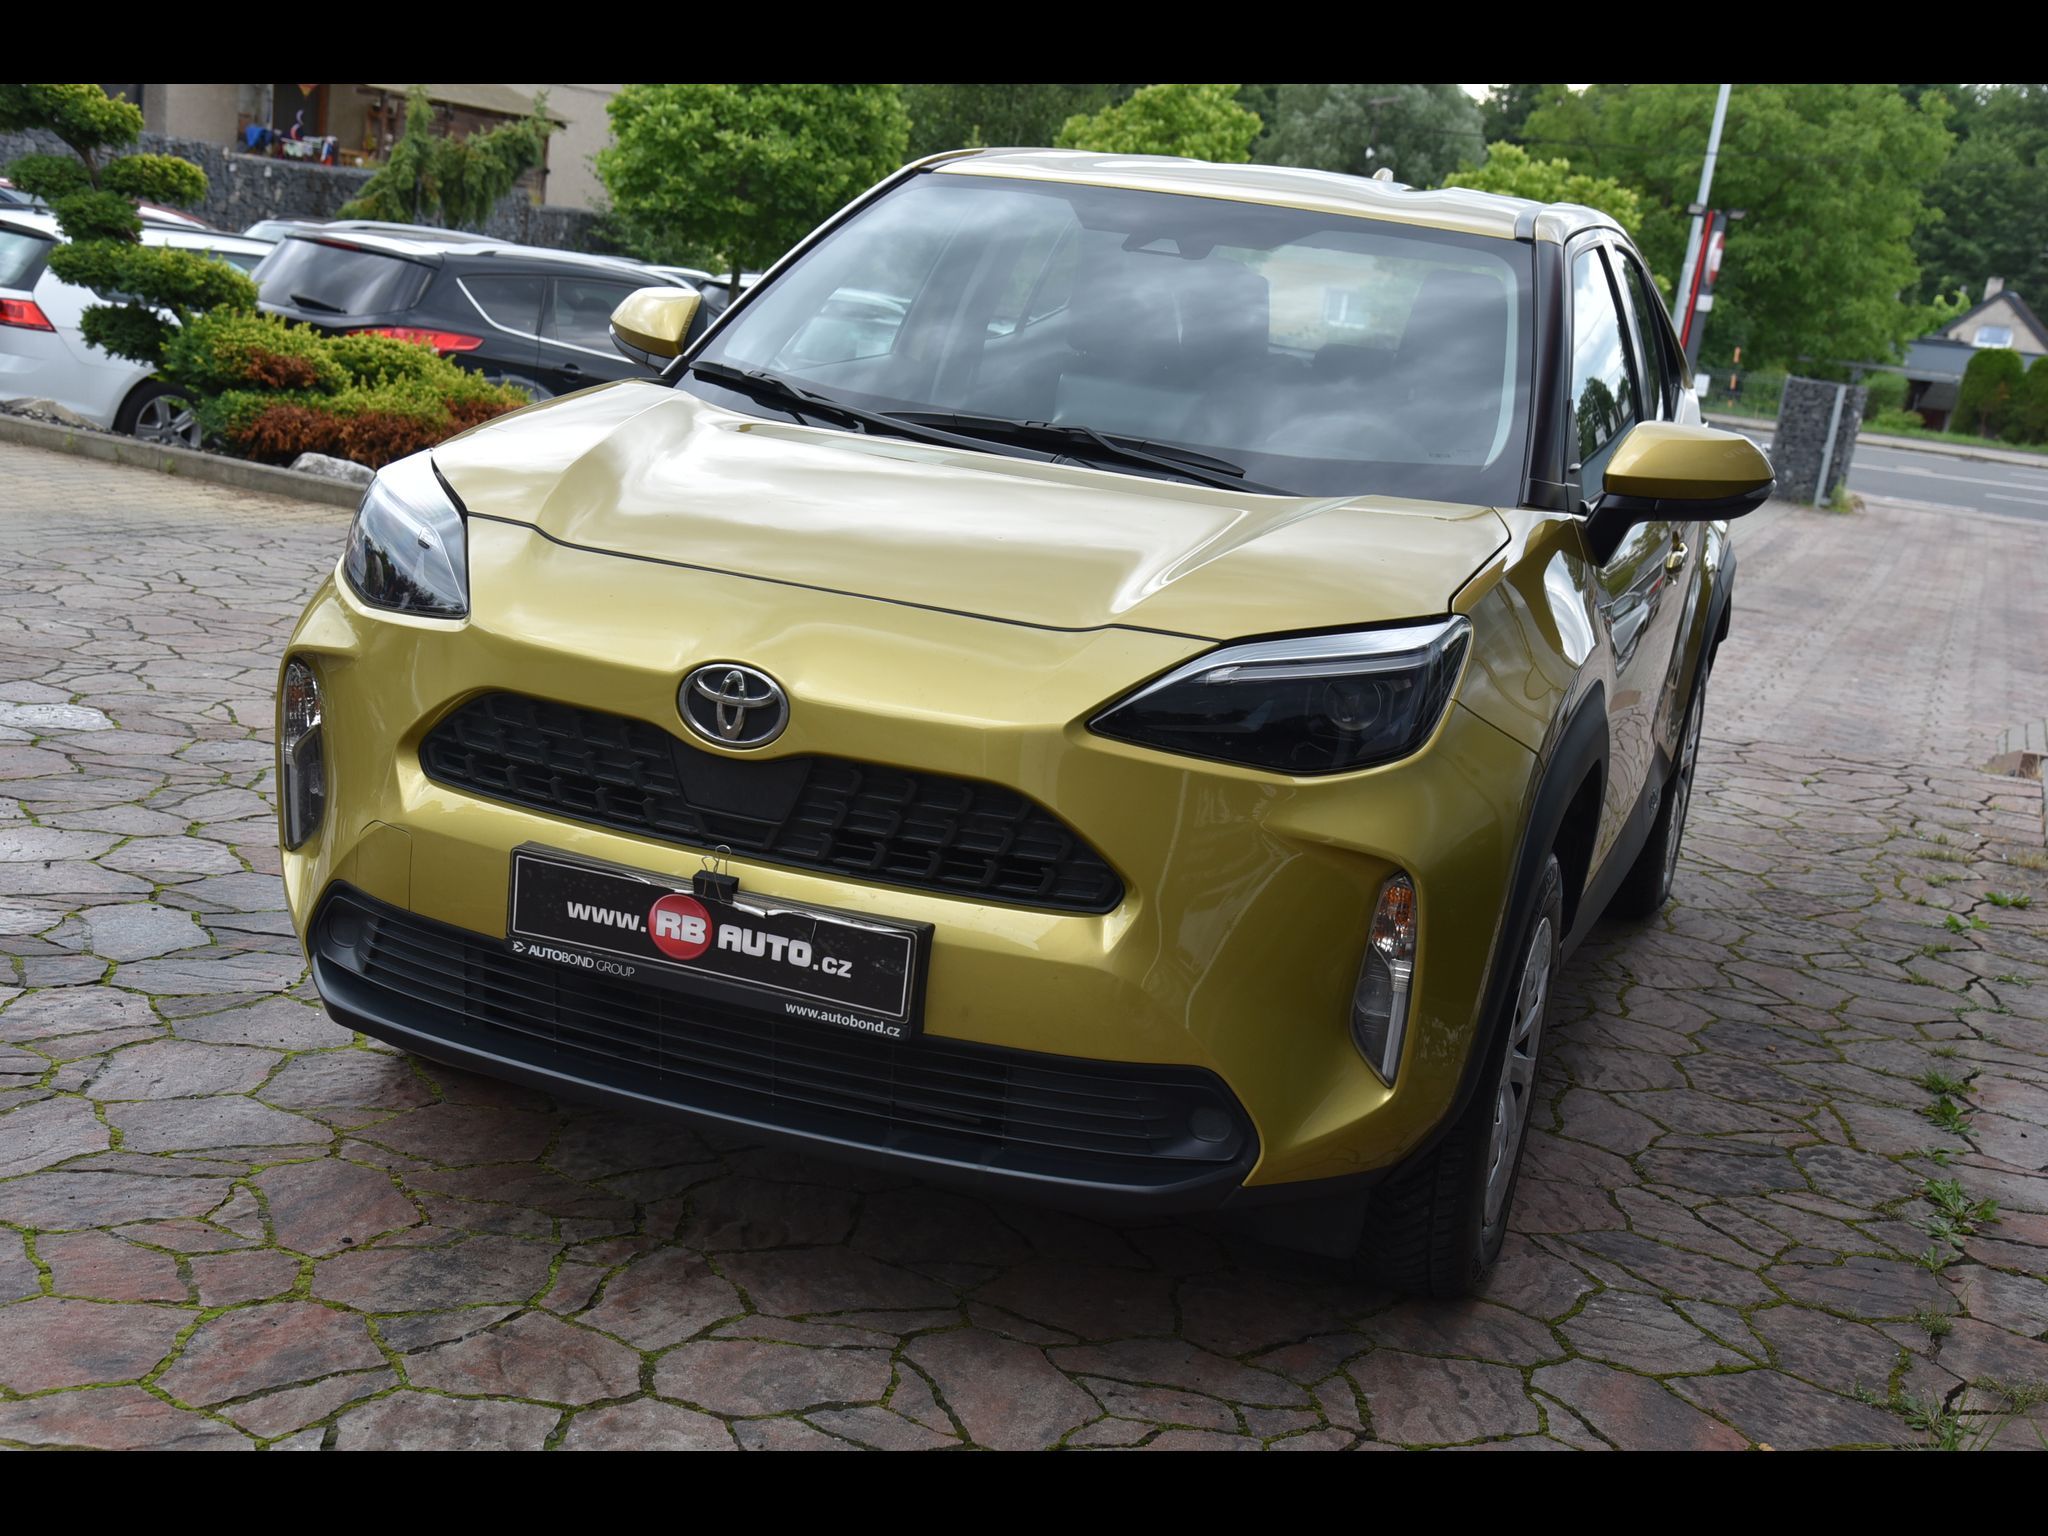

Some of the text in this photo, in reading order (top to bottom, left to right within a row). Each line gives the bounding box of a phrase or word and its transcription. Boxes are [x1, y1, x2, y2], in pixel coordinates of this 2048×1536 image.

[567, 901, 647, 933] www.
[655, 909, 707, 945] RB
[528, 944, 636, 977] AUTOBOND GROUP
[785, 1003, 901, 1038] www.autobond.cz
